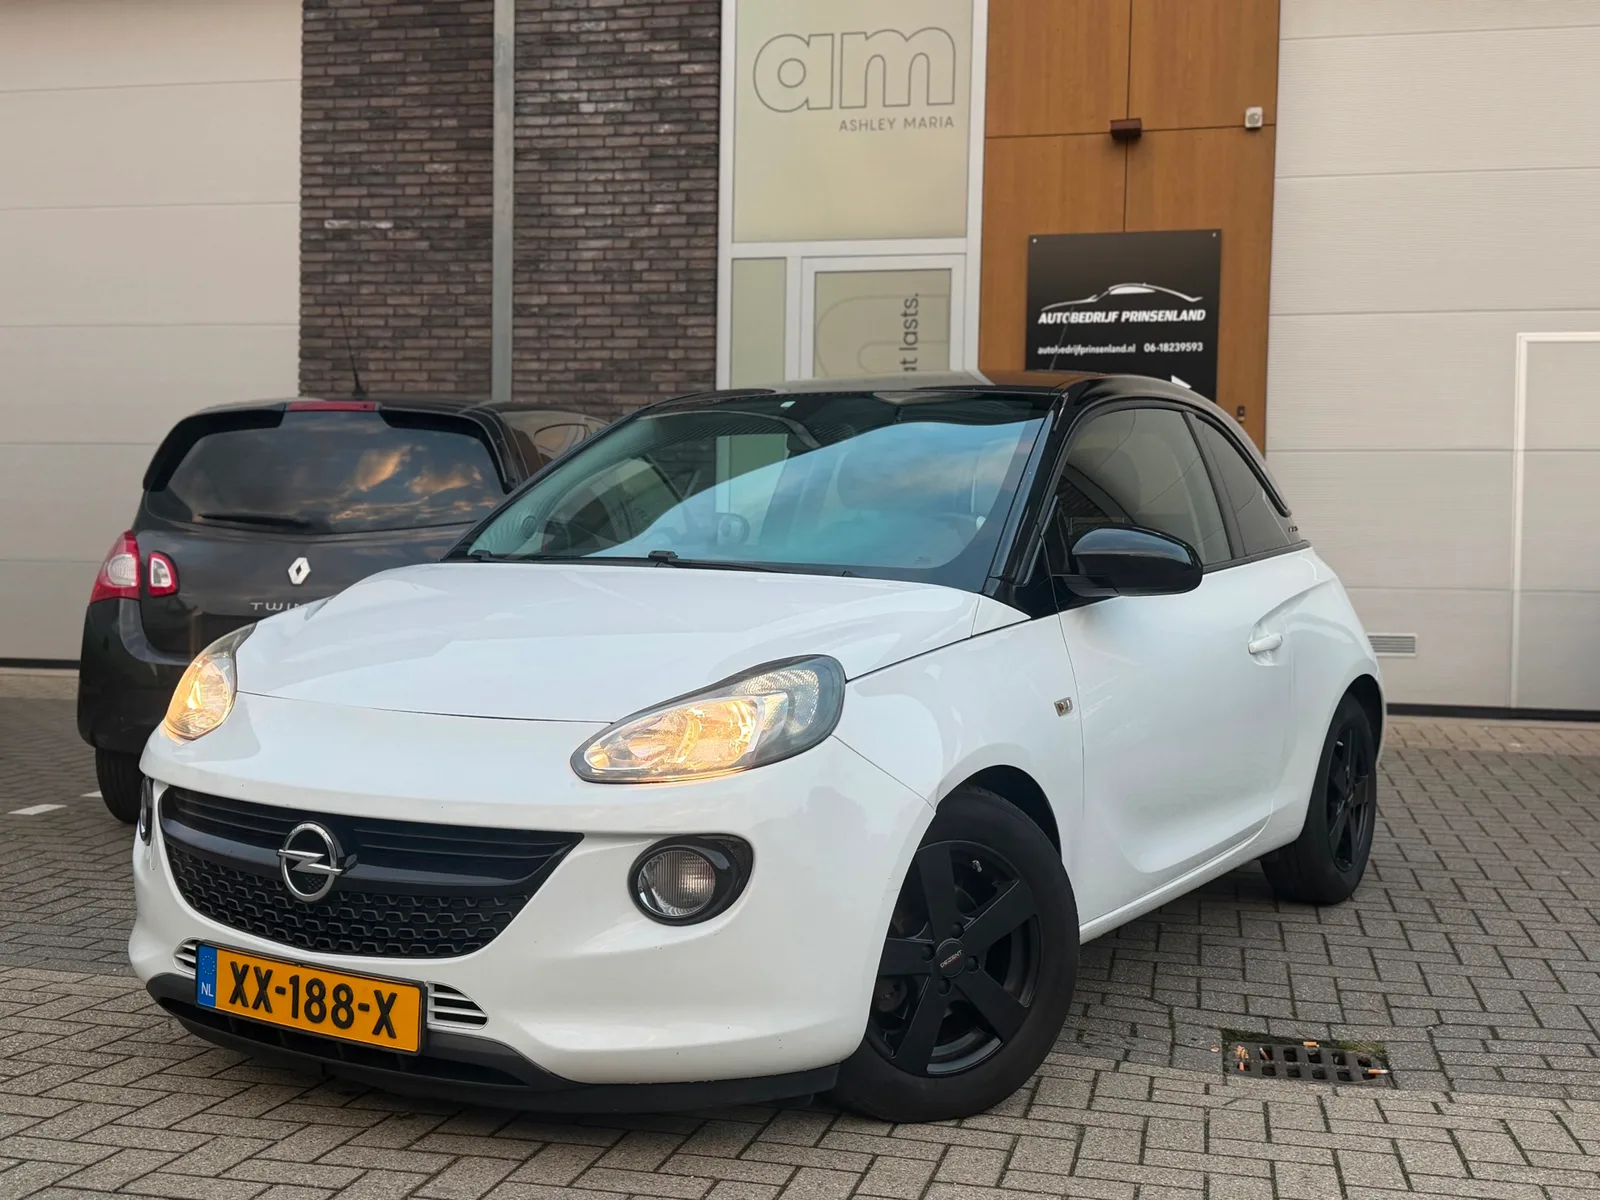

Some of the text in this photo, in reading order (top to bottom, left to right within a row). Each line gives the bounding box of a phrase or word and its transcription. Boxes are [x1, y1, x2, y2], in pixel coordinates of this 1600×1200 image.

[753, 26, 956, 113] am
[839, 115, 955, 132] ASHLEY MARIA
[898, 292, 919, 351] lasts.
[1037, 309, 1206, 325] AUTOBEDRIJF PRINSENLAND
[1037, 342, 1204, 356] autobedrijfprinsenland.nl 06-18239593
[200, 981, 214, 998] NL
[229, 961, 398, 1039] XX-188-X
